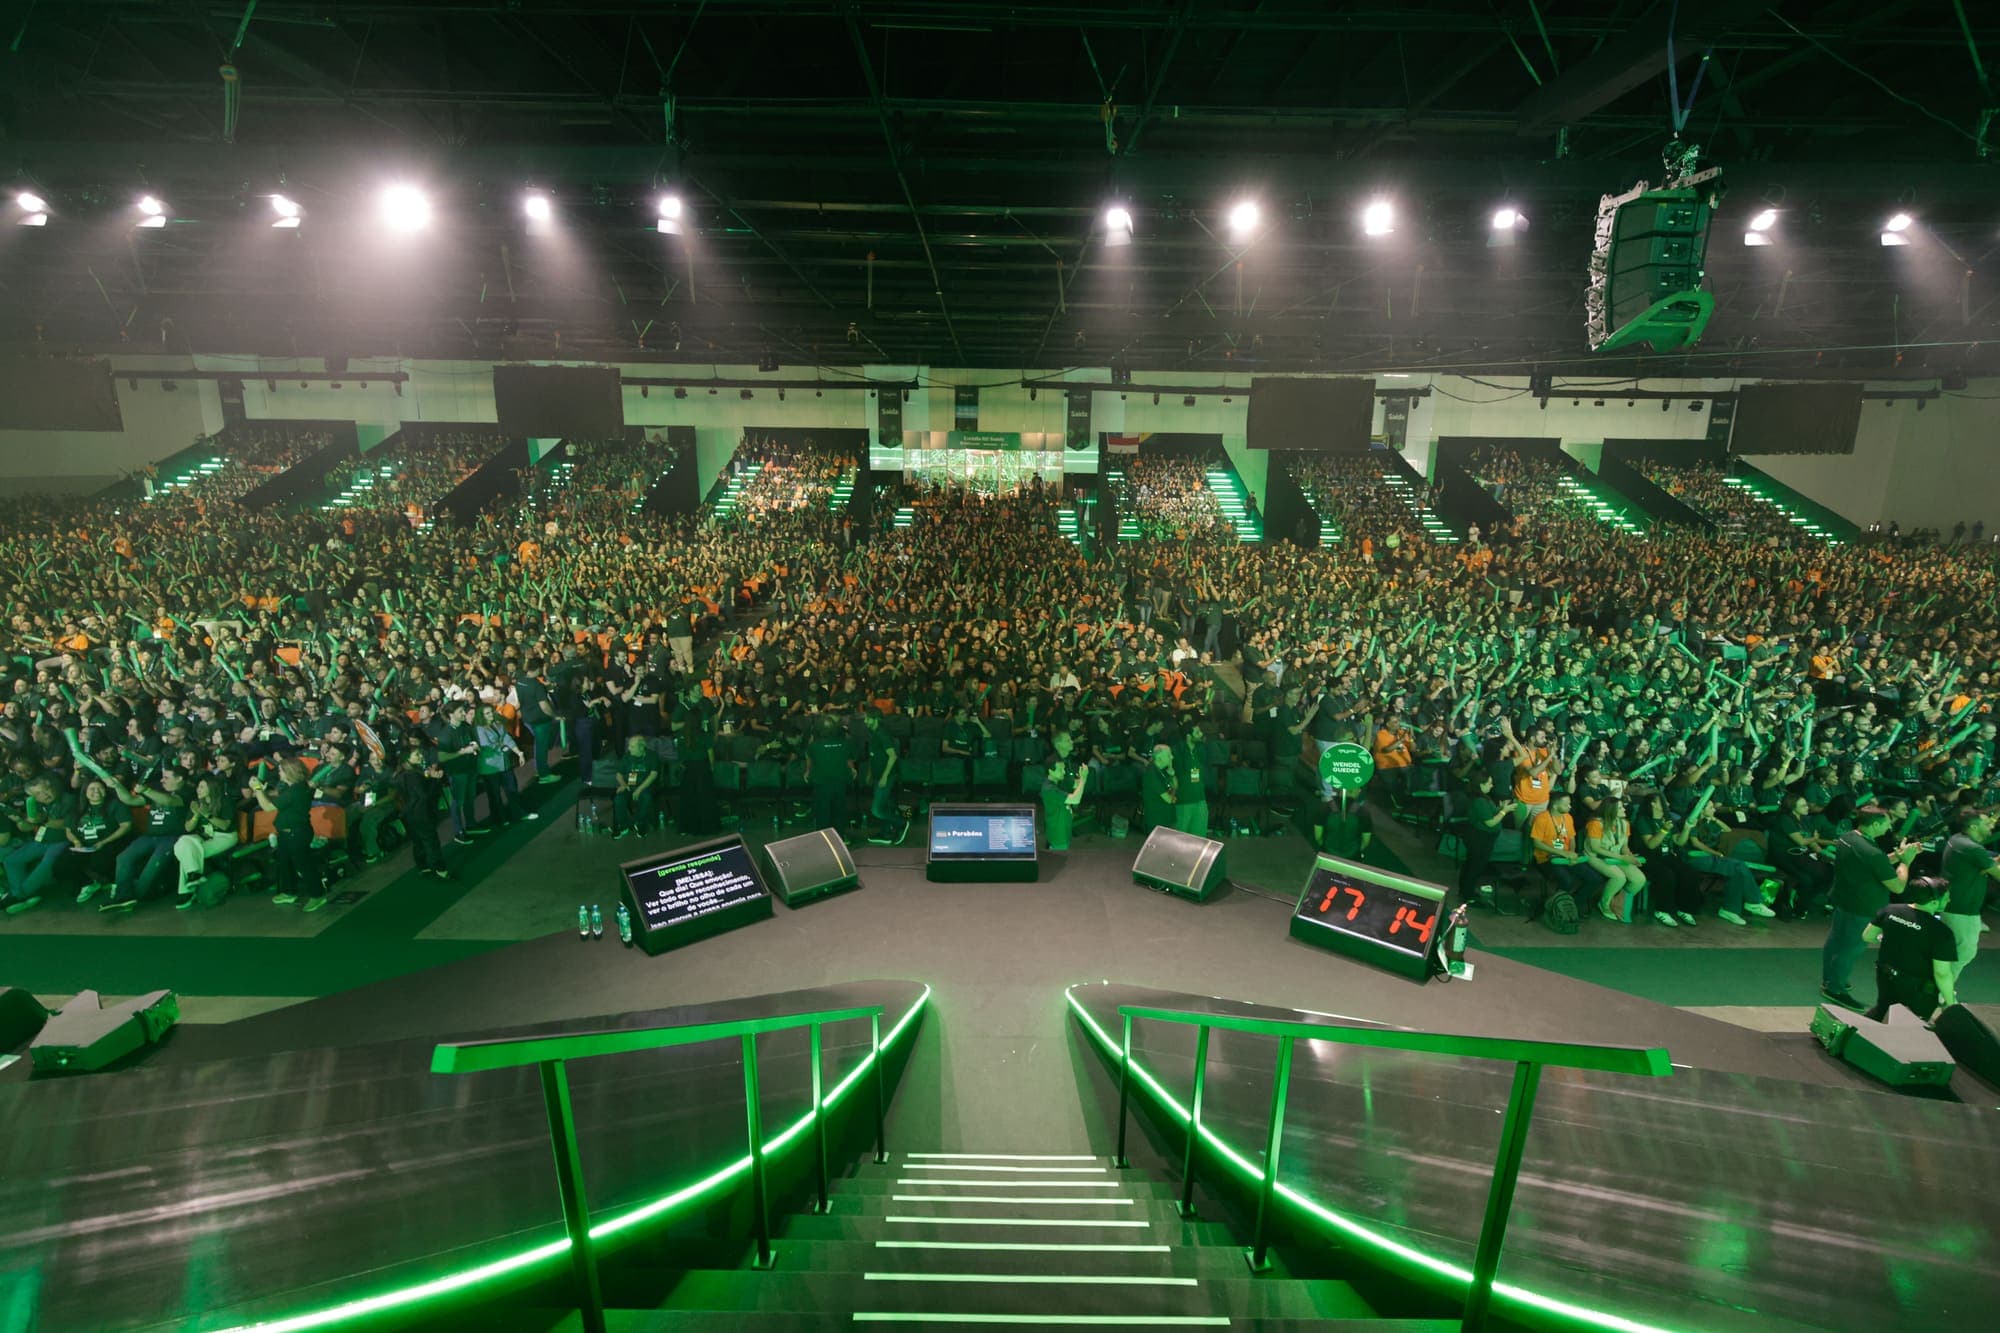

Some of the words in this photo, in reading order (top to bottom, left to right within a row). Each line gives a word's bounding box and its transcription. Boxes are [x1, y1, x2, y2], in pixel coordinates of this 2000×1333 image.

[645, 900, 659, 908] Ver
[660, 895, 677, 904] todo
[677, 890, 694, 899] esse
[648, 908, 660, 916] ver
[667, 899, 689, 910] brilho
[700, 891, 716, 901] olho
[715, 888, 725, 896] de
[725, 883, 743, 893] cada
[743, 880, 754, 888] um
[659, 889, 674, 897] Que
[675, 884, 689, 893] dia!
[689, 881, 704, 889] Que
[704, 871, 734, 884] emoção!
[1319, 886, 1365, 921] 17
[1389, 906, 1436, 943] 14
